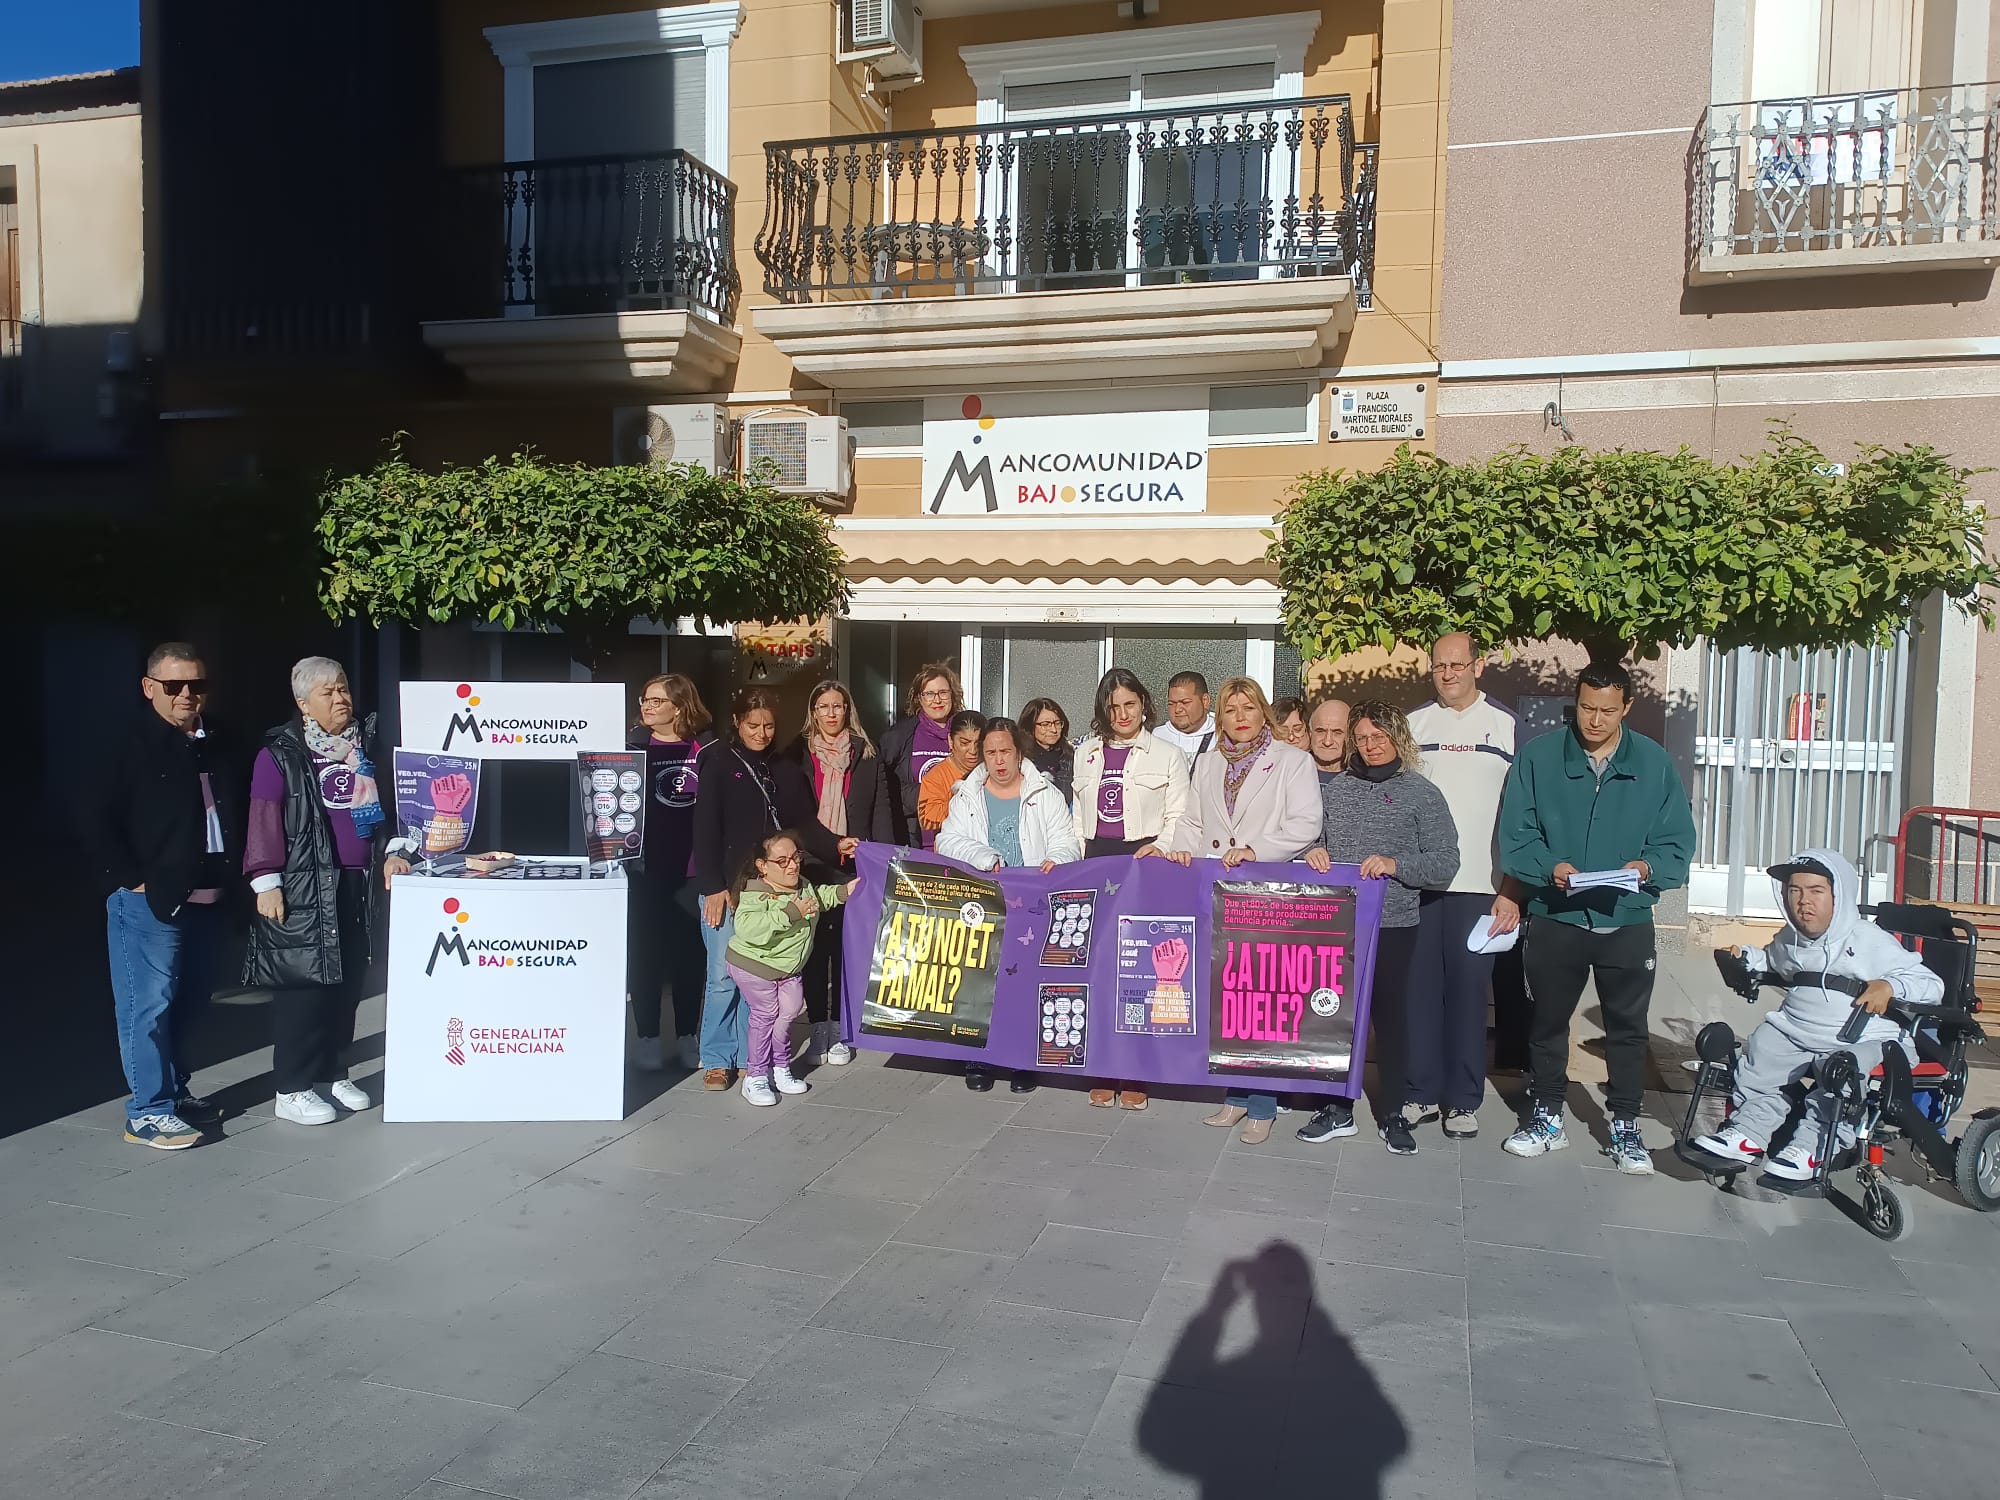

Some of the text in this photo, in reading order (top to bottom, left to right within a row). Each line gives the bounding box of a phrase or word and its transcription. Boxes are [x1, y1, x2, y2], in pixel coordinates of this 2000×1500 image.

[1366, 391, 1389, 400] PLAZA
[1357, 403, 1398, 413] FRANCISCO
[1342, 413, 1413, 424] MARTINEZ MORALES
[1371, 424, 1380, 433] EL
[930, 450, 1204, 514] MANCOMUNIDAD
[1080, 481, 1185, 504] SEGURA
[442, 712, 588, 751] MANCOMUNIDAD
[525, 733, 579, 744] SEGURA
[1440, 743, 1475, 752] adidas
[1224, 898, 1339, 912] Que el 80% de los asesinatos
[1224, 915, 1260, 925] denuncia
[1231, 908, 1263, 919] mujeres
[1275, 910, 1318, 919] produzcan
[1319, 912, 1332, 920] sin
[884, 911, 903, 959] A
[905, 913, 936, 963] TU
[932, 917, 966, 966] NO
[964, 921, 996, 969] ET
[425, 931, 588, 977] MANCOMUNIDAD
[516, 954, 577, 967] SEGURA
[1222, 941, 1253, 990] ¿A
[1256, 943, 1277, 992] TI
[1280, 944, 1313, 994] NO
[1316, 945, 1344, 995] TE
[903, 962, 963, 1015] MAL?
[1318, 996, 1331, 1008] 016
[1221, 990, 1304, 1044] DUELE?
[469, 1027, 568, 1040] GENERALITAT
[470, 1041, 565, 1054] VALENCIANA
